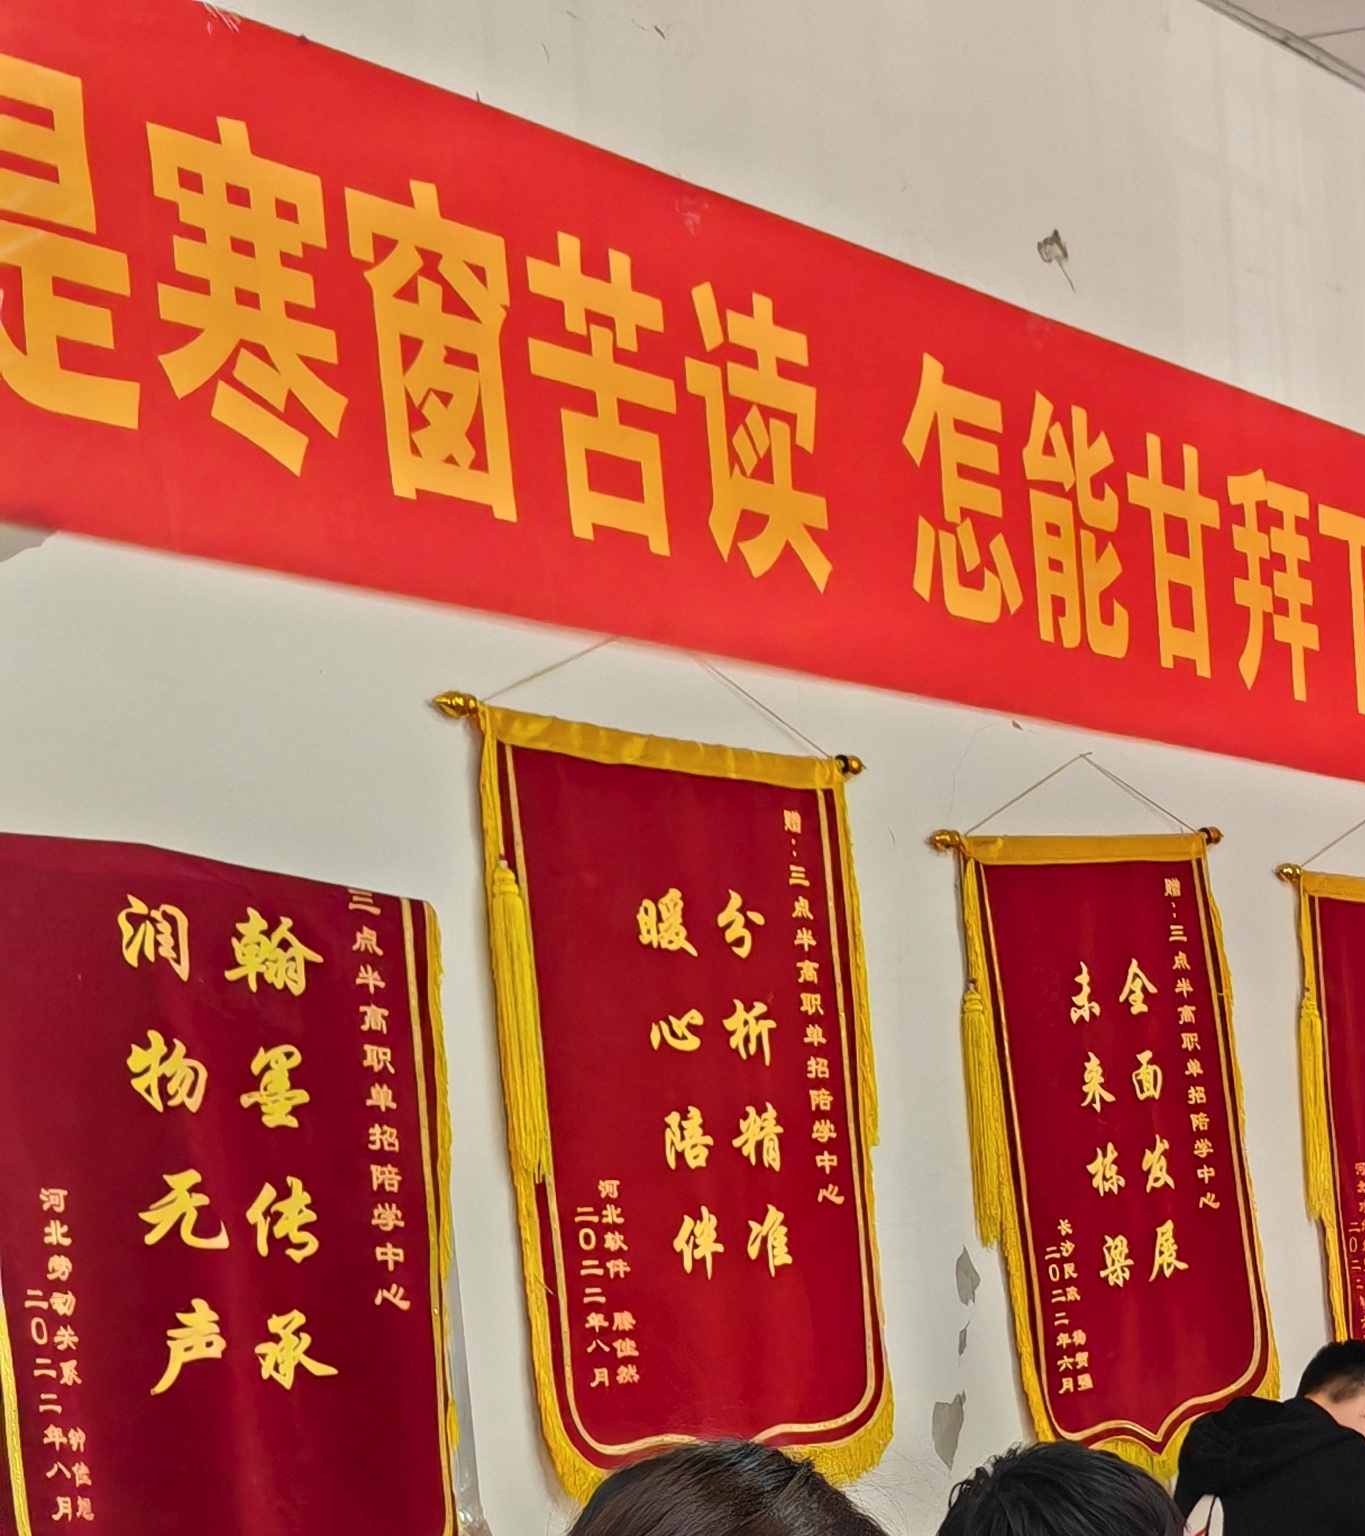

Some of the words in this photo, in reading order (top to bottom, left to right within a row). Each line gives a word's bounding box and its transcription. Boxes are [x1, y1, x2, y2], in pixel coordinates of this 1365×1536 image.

[0, 54, 833, 594] 是寒窗苦读
[117, 894, 230, 1396] 润物无声
[224, 906, 339, 1393] 翰墨传承
[637, 887, 725, 1280] 暖心陪伴
[716, 889, 793, 1279] 分析精准
[1069, 960, 1135, 1288] 未来栋梁
[1118, 957, 1190, 1284] 全面发展
